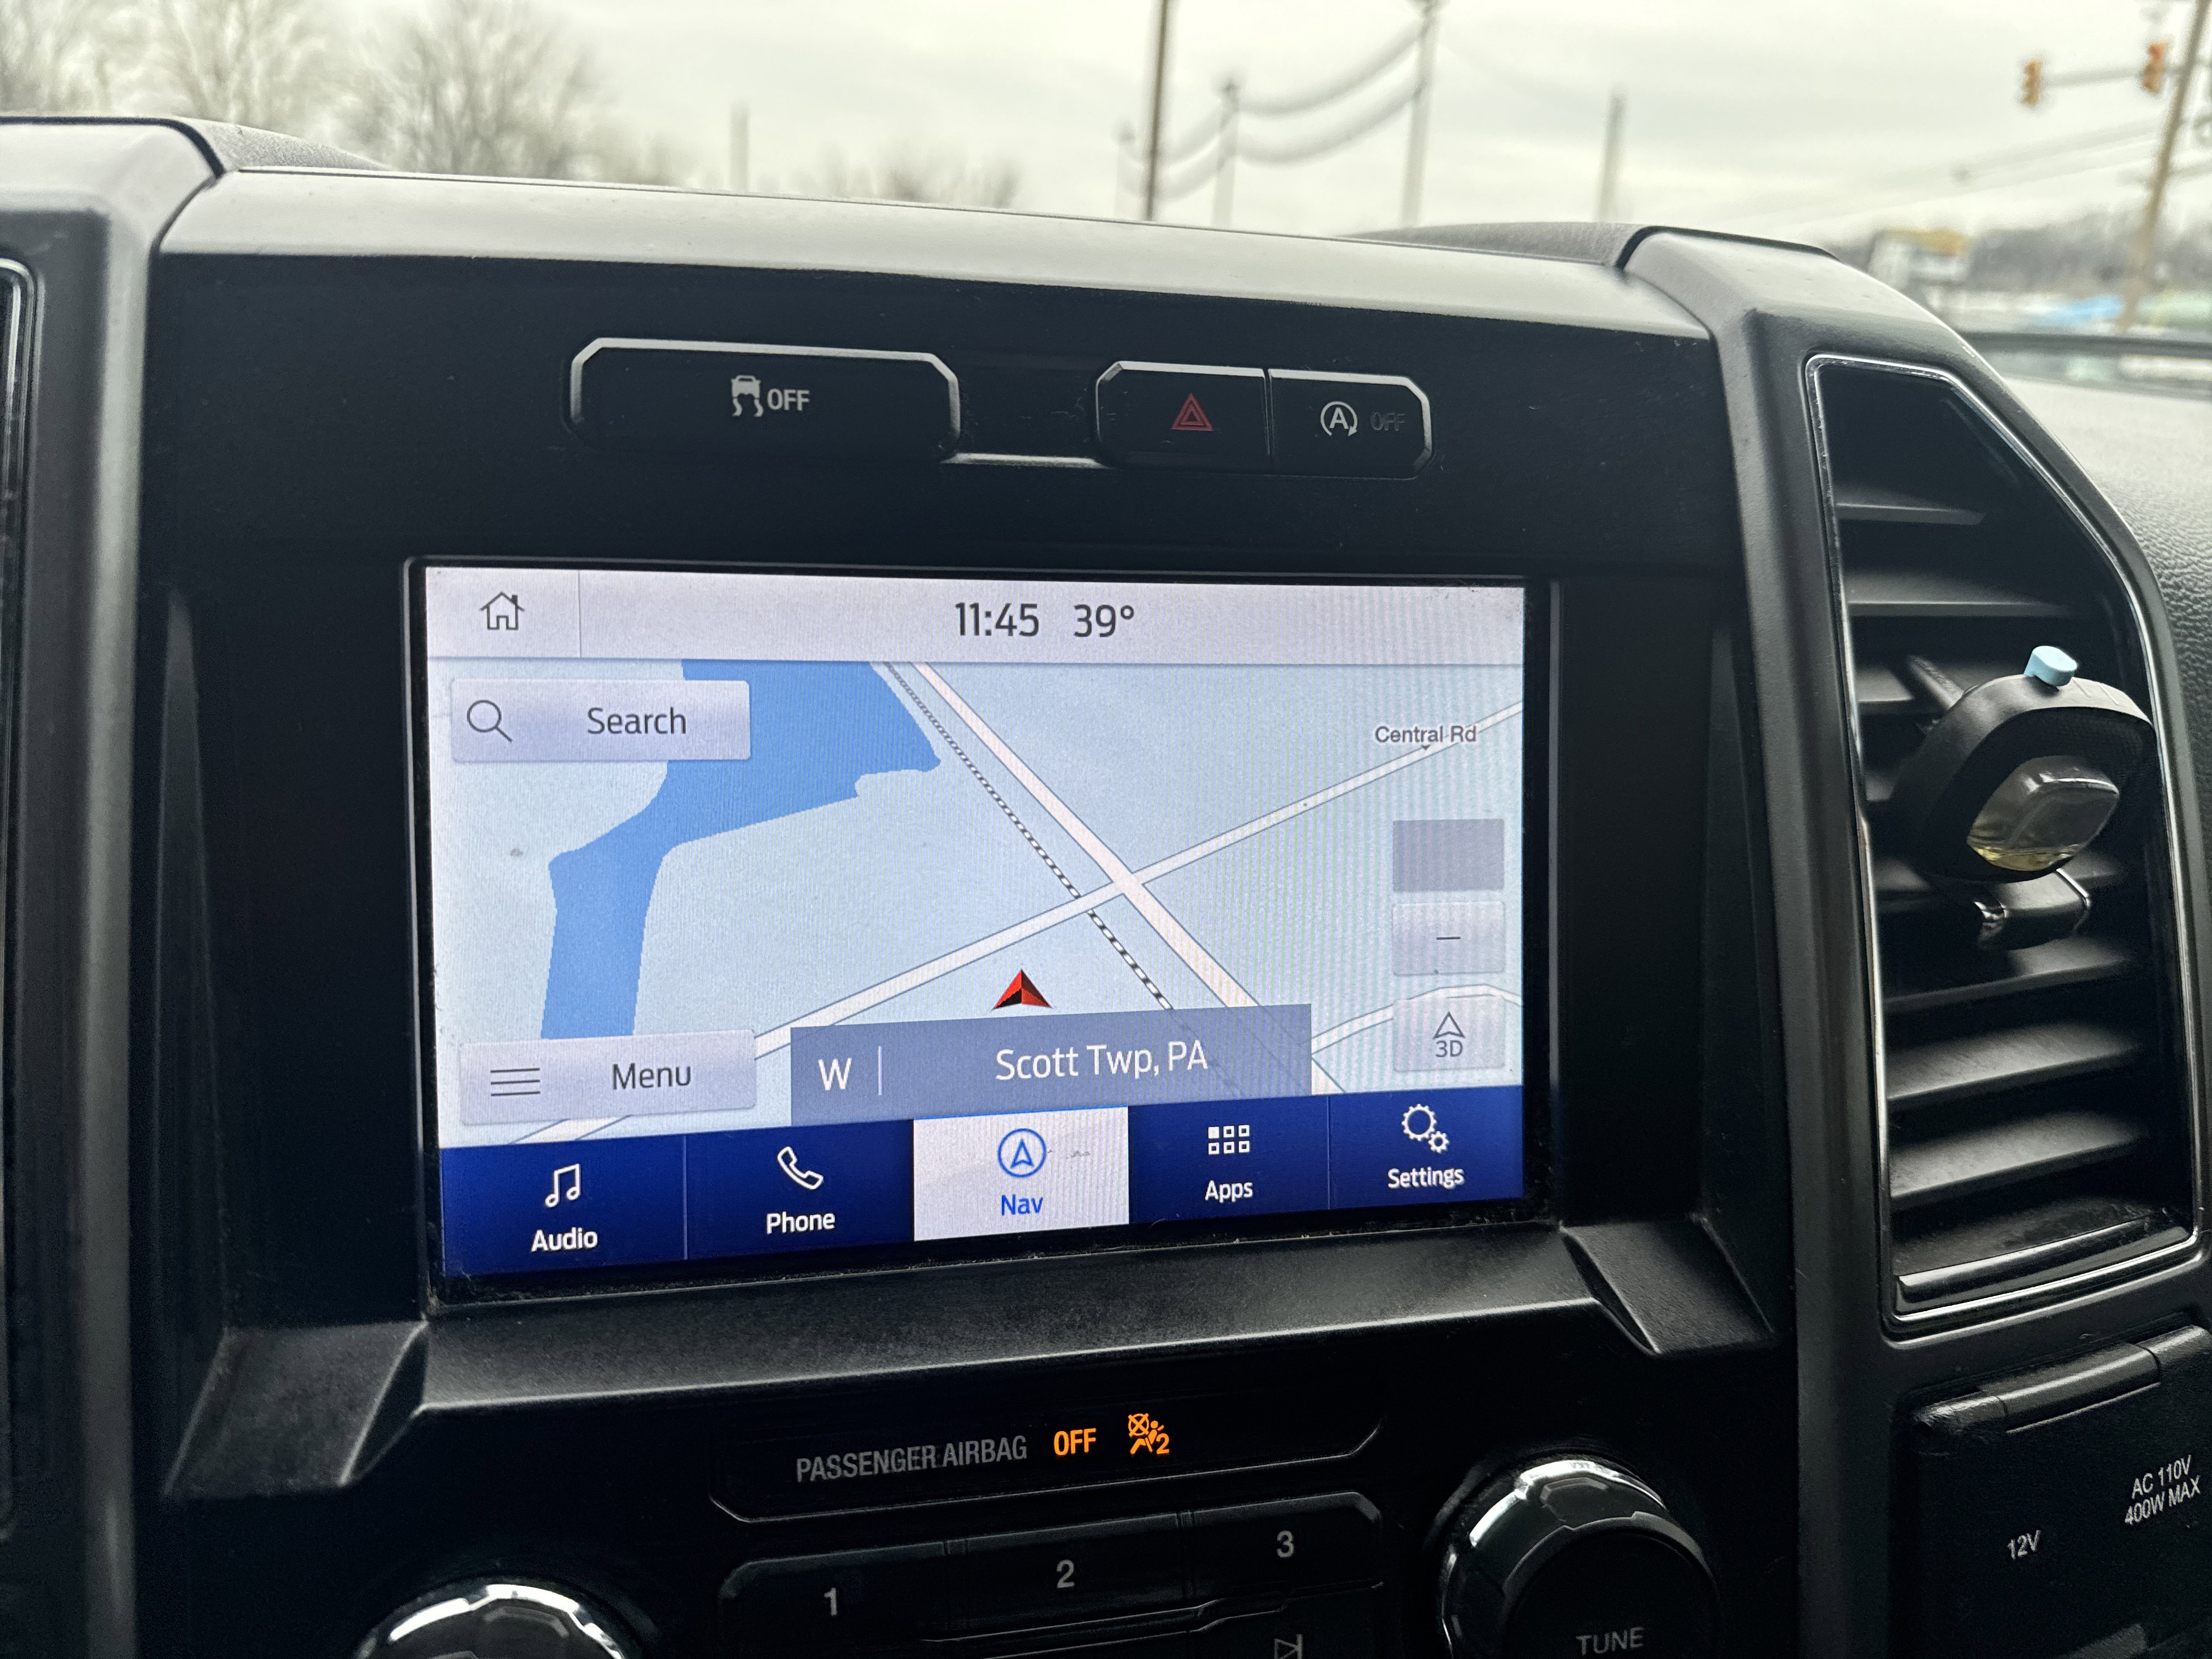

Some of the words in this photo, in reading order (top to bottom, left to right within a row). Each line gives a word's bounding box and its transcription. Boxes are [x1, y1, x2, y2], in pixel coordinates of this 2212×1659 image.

[767, 388, 810, 411] OFF
[1372, 411, 1405, 431] OFF
[955, 602, 1039, 636] 11:45
[1074, 604, 1135, 637] 39°
[587, 707, 687, 735] Search
[1375, 725, 1443, 743] Central
[1451, 725, 1477, 742] Rd
[995, 1048, 1079, 1081] Scott
[1087, 1044, 1160, 1079] Twp,
[1168, 1040, 1209, 1070] PA
[1435, 1040, 1463, 1058] 3D
[612, 1063, 692, 1090] Menu
[818, 1057, 851, 1091] W
[1387, 1165, 1465, 1190] Settings
[1000, 1193, 1043, 1216] Nav
[1205, 1180, 1254, 1203] Apps
[766, 1211, 836, 1234] Phone
[531, 1227, 598, 1252] Audio
[797, 1444, 937, 1482] PASSENGER
[943, 1435, 1027, 1468] AIRBAG
[1053, 1427, 1097, 1457] OFF
[2131, 1472, 2153, 1499] AC
[2158, 1454, 2192, 1486] 110V
[2124, 1491, 2165, 1525] 400W
[2168, 1475, 2200, 1506] MAX
[1276, 1531, 1294, 1558] 3
[2007, 1530, 2041, 1560] 12V
[1056, 1560, 1076, 1588] 2
[823, 1587, 838, 1616] 1
[1575, 1626, 1646, 1656] TUNE
